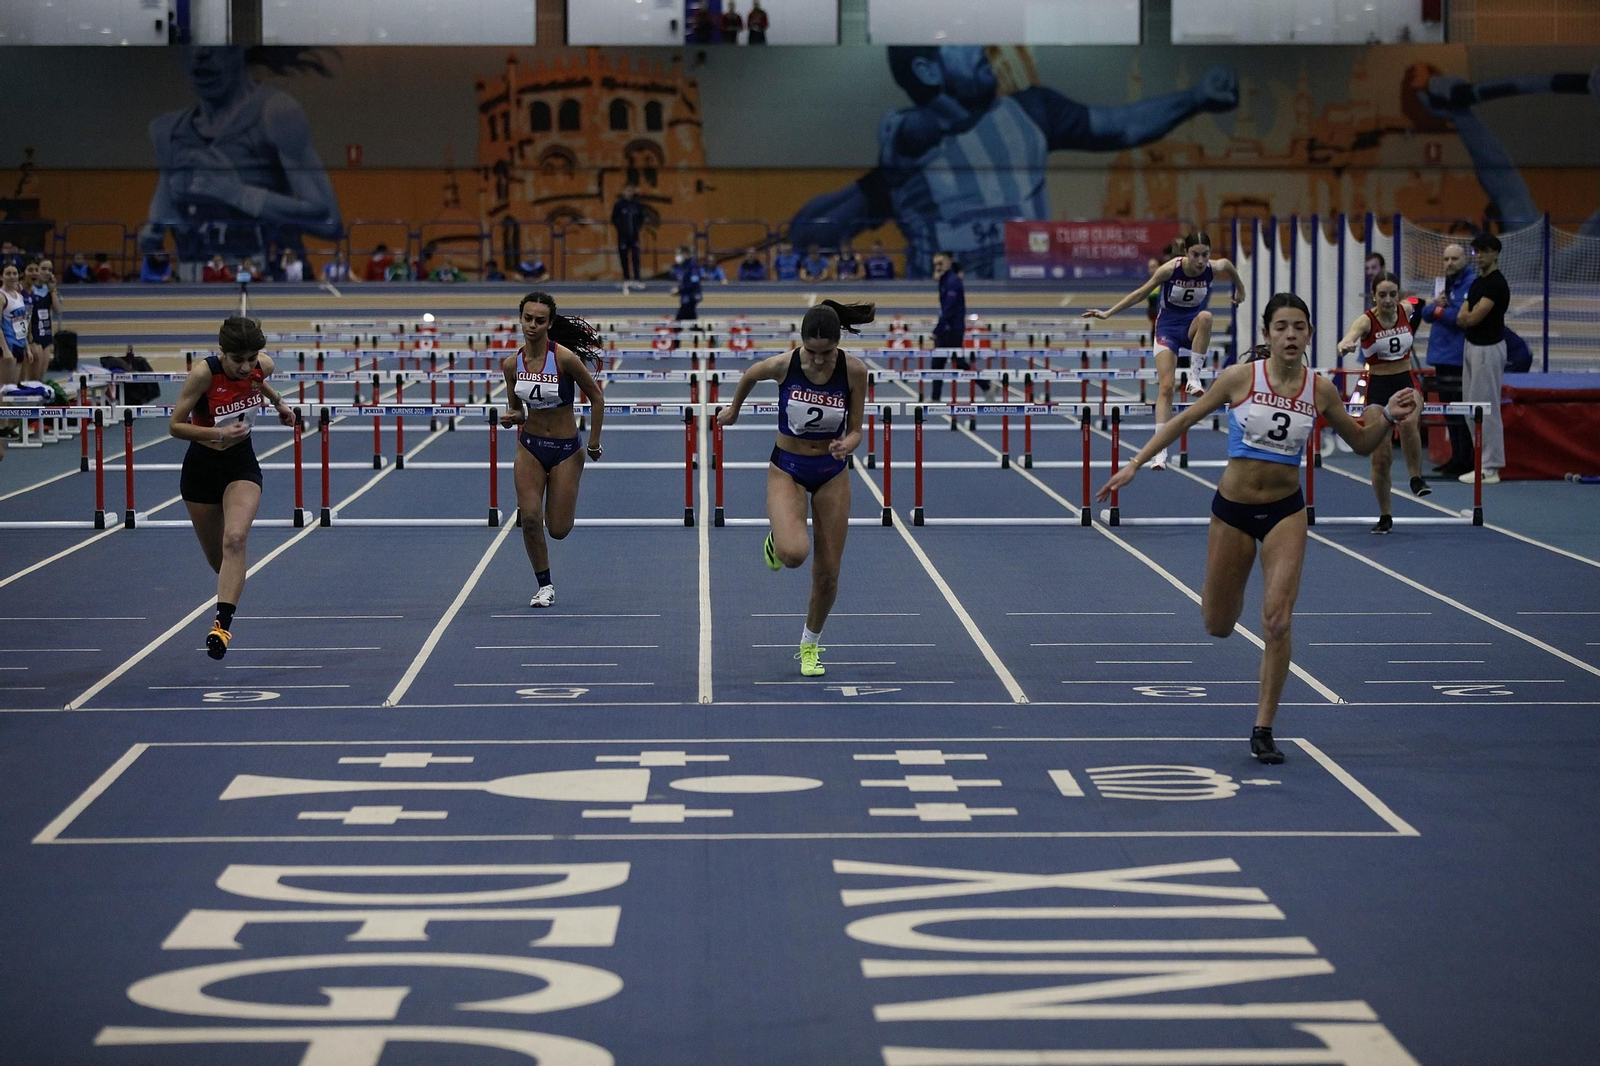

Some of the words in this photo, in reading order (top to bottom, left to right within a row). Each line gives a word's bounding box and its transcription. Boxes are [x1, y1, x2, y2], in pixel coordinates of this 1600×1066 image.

[1056, 228, 1089, 243] CLUB
[1072, 245, 1139, 258] ATLETISMO
[1182, 289, 1195, 302] 6
[1375, 329, 1397, 339] CLUBS
[1396, 326, 1409, 334] S16
[1389, 337, 1401, 353] 8
[518, 372, 542, 382] CLUBS
[542, 374, 558, 382] S16
[528, 384, 545, 402] 4
[791, 390, 825, 405] CLUBS
[826, 396, 844, 408] S16
[215, 400, 246, 415] CLUBS
[247, 393, 262, 407] S16
[1253, 393, 1292, 410] CLUBS
[1293, 401, 1314, 416] S16
[804, 407, 824, 428] 2
[1267, 412, 1291, 442] 3
[202, 690, 281, 702] 6
[515, 687, 590, 699] 5
[823, 686, 901, 697] 4
[1132, 686, 1207, 697] 3
[1432, 685, 1514, 696] 2
